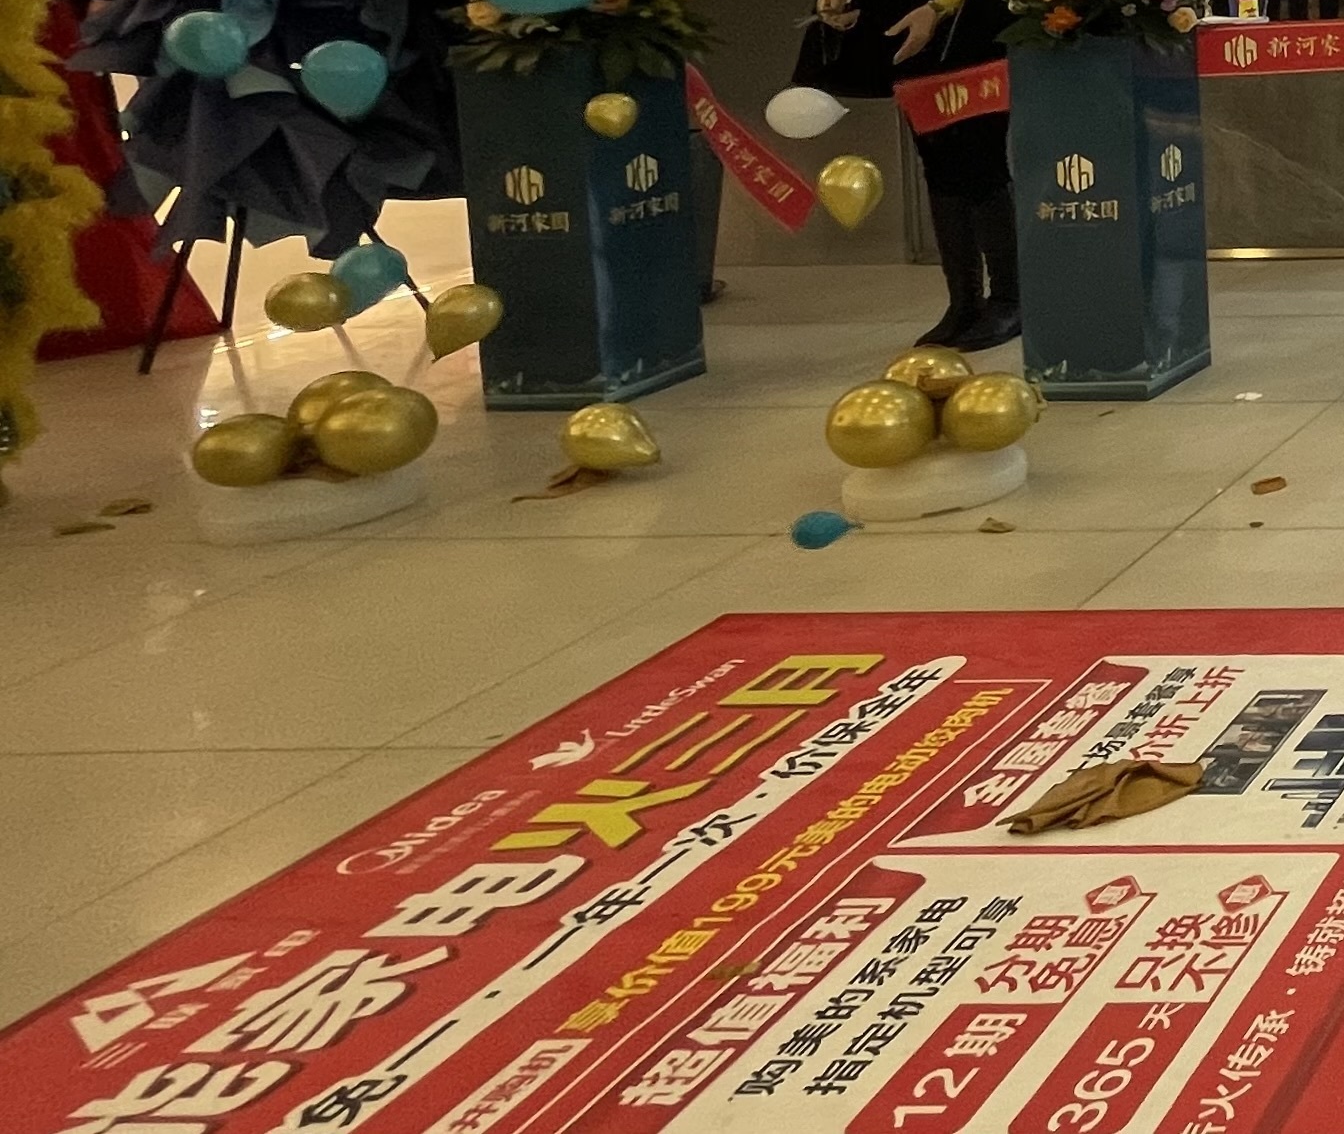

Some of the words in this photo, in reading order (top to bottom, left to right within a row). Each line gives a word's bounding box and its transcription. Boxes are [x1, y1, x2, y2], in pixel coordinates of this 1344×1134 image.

[962, 680, 1132, 809] 全屋套餐
[336, 789, 508, 875] Midea
[618, 896, 897, 1106] 超值福利
[733, 896, 969, 1098] 购美的系家电
[802, 894, 1025, 1096] 指定机型可享
[974, 914, 1080, 996] 分期
[1027, 911, 1129, 994] 免息
[1114, 912, 1212, 993] 只换
[1168, 911, 1262, 993] 不修
[892, 1012, 1028, 1130] 12期
[1047, 1002, 1186, 1134] 365天
